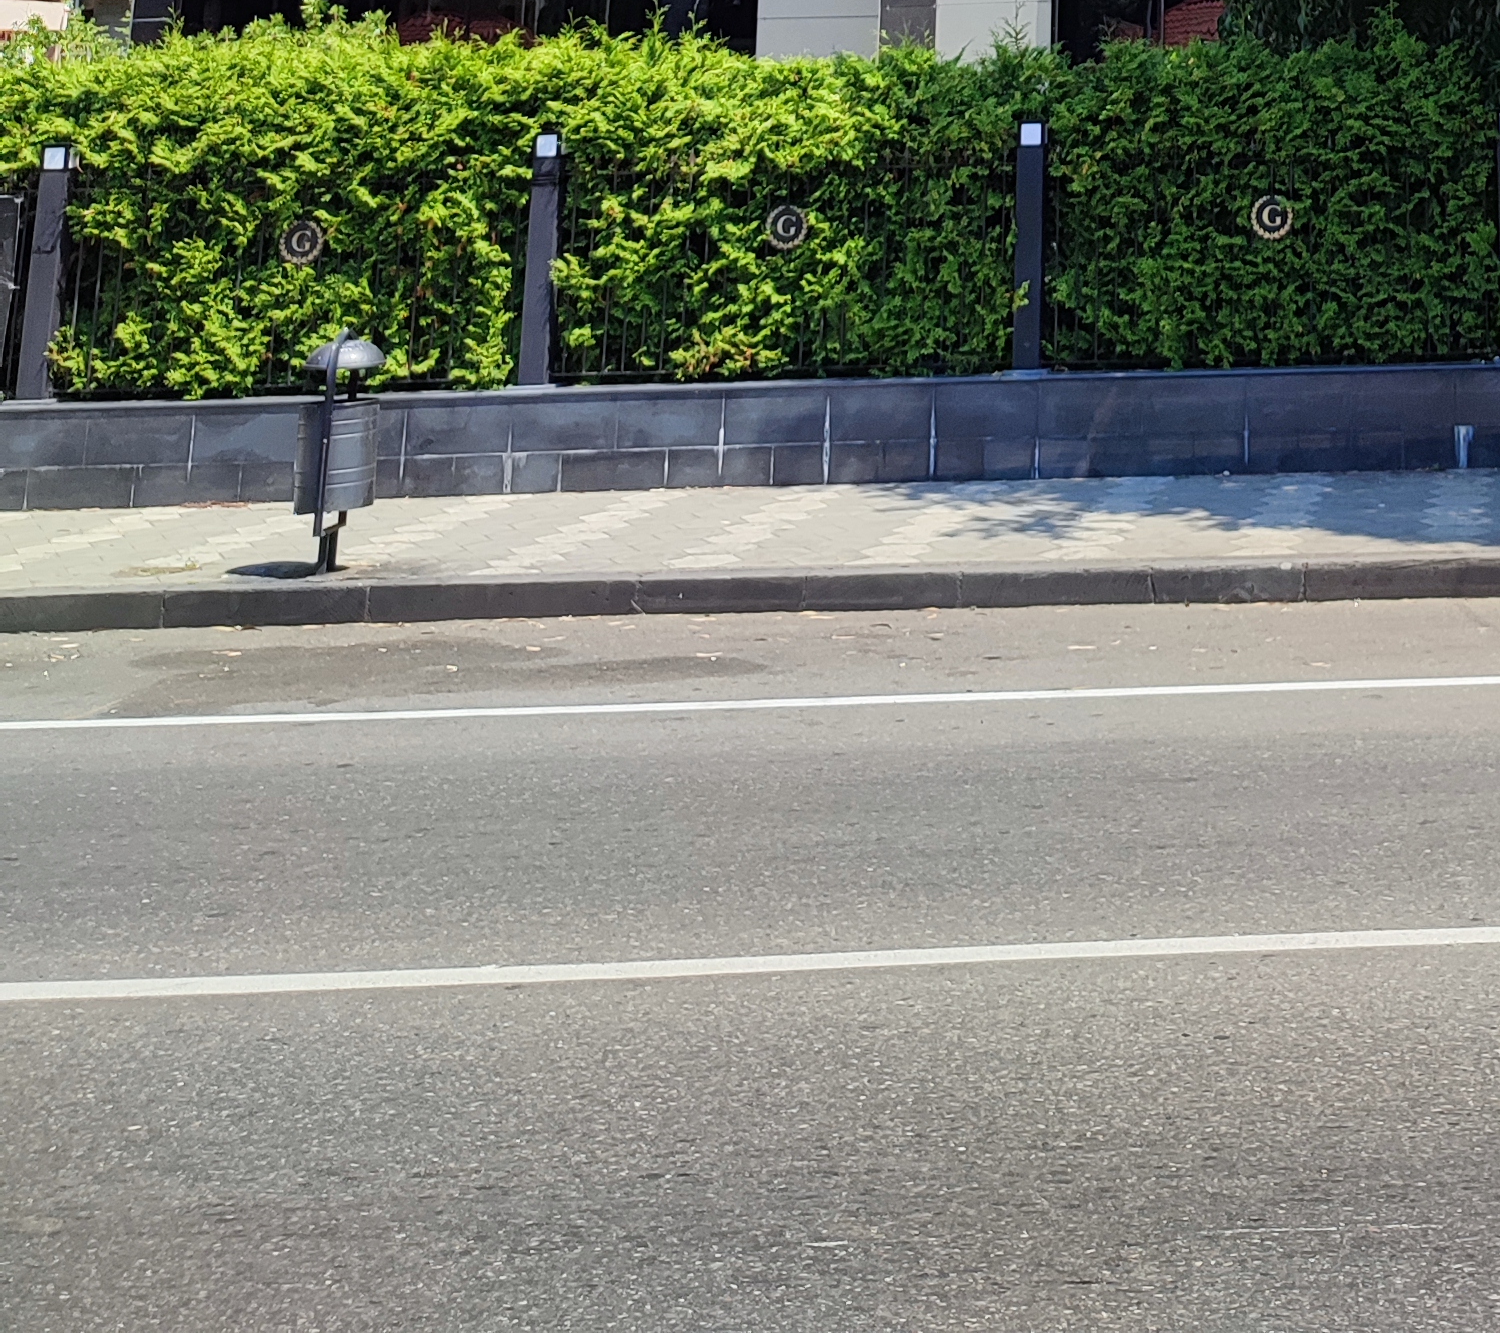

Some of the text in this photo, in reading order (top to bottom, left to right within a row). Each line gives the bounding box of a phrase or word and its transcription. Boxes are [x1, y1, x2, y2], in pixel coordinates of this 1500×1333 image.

[777, 215, 796, 237] G
[1262, 205, 1281, 226] G
[291, 230, 311, 252] G
